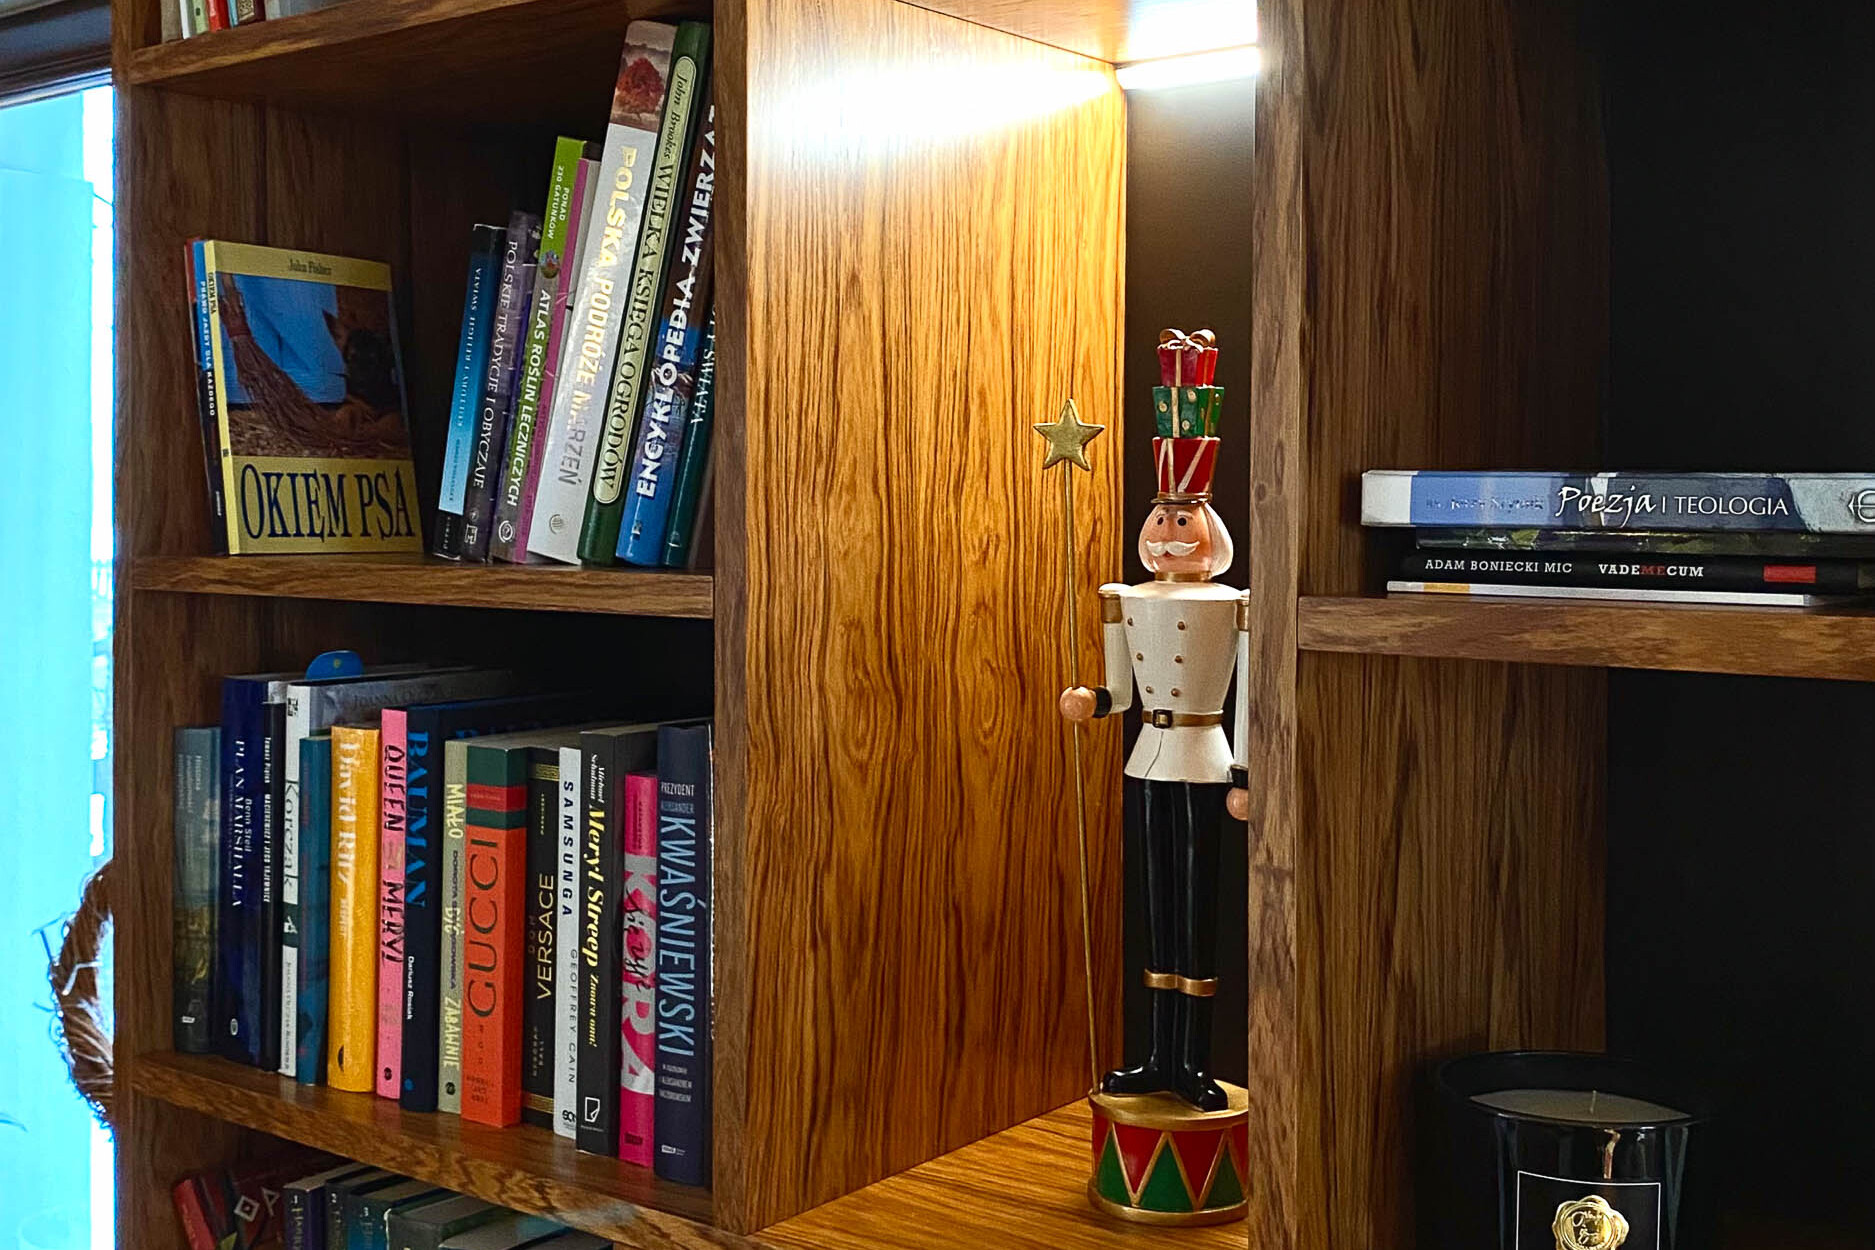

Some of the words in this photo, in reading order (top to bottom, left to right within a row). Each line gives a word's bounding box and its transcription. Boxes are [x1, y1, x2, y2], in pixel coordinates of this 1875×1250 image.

[673, 73, 688, 106] John
[663, 111, 681, 160] Brookes
[559, 186, 570, 221] PONAD
[597, 145, 638, 268] POLSKA
[642, 164, 674, 259] WIELKA
[499, 240, 518, 309] POLSKIE
[533, 289, 551, 340] ATLAS
[623, 267, 655, 355] KSIĘGA
[487, 313, 508, 394] TRADYCJE
[523, 342, 542, 401] ROŚLIN
[575, 276, 615, 387] PODRÓŻE
[600, 361, 636, 490] OGRODÓW
[636, 273, 696, 498] ENCYKLOPEDIA
[472, 406, 494, 489] OBYCZAJE
[506, 405, 533, 507] LECZNICZYCH
[240, 463, 353, 544] OKIEM
[353, 465, 416, 541] PSA
[1555, 484, 1658, 529] Poezja
[1673, 495, 1789, 516] TEOLOGIA
[1424, 558, 1466, 571] ADAM
[1470, 560, 1539, 573] BONIECKI
[1544, 562, 1573, 574] MIC
[1599, 563, 1705, 578] VADEMECUM
[235, 740, 245, 790] PLAN
[338, 742, 361, 822] David
[383, 744, 406, 832] QUEEN
[660, 781, 696, 798] PREZYDENT
[232, 795, 245, 906] MARSHALLA
[245, 798, 253, 825] Benn
[283, 779, 299, 889] Korczak
[405, 731, 429, 909] BAUMAN
[446, 783, 467, 840] MIAŁO
[562, 780, 575, 916] SAMSUNGA
[583, 802, 605, 883] Meryl
[451, 850, 459, 899] DOROTA
[467, 838, 499, 1018] GUCCI
[537, 873, 554, 1000] VERSACE
[581, 885, 604, 968] Streep
[658, 815, 707, 1057] KWAŚNIEWSKI
[406, 990, 415, 1020] Rosiak
[407, 955, 415, 989] Dariusz
[442, 995, 462, 1072] ZABAWNIE
[567, 1042, 577, 1084] CAIN
